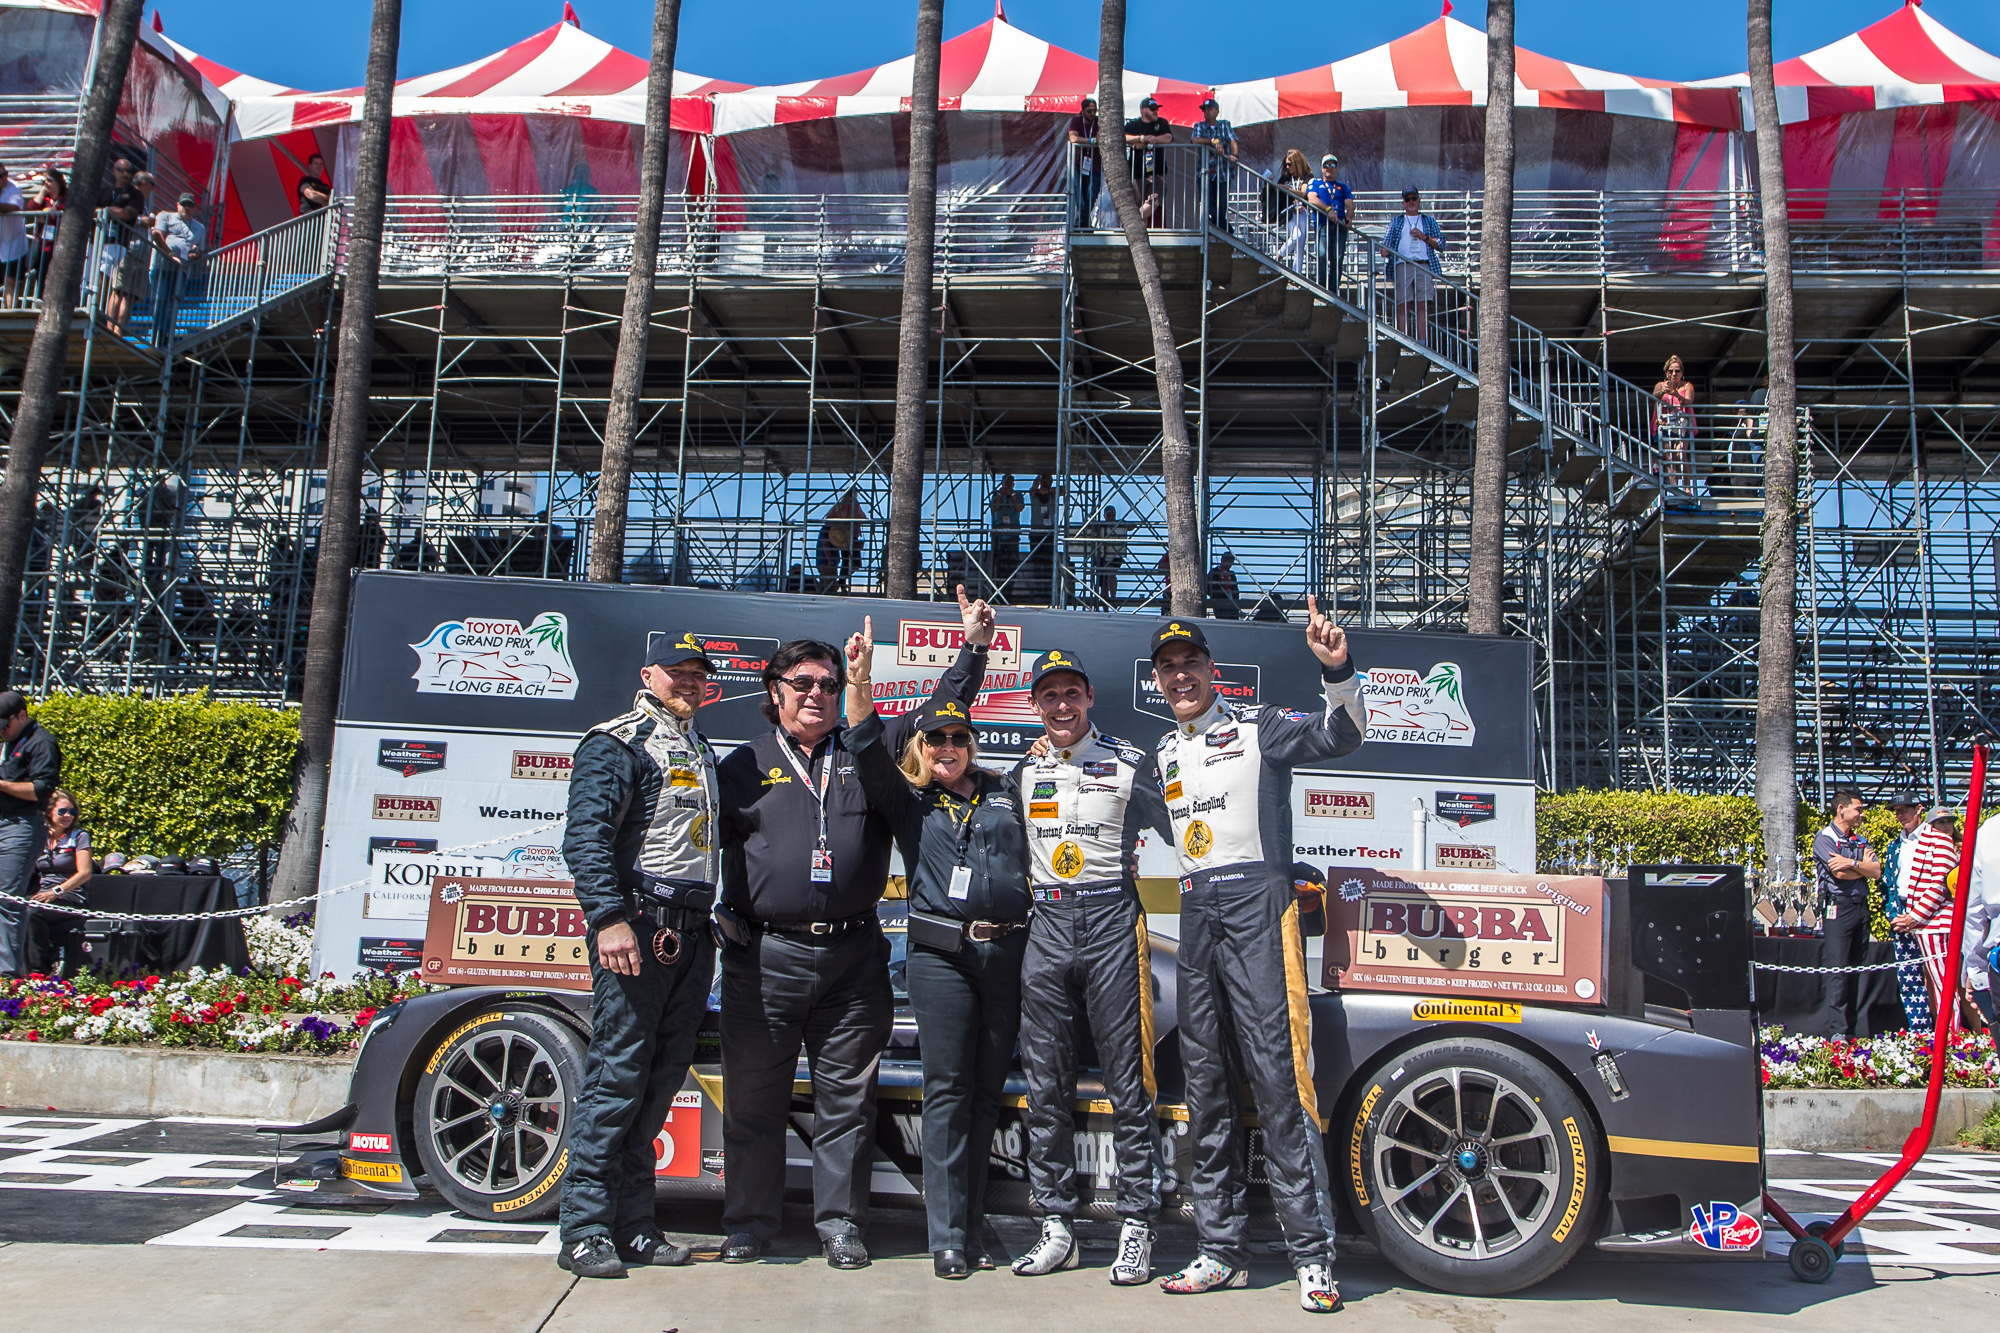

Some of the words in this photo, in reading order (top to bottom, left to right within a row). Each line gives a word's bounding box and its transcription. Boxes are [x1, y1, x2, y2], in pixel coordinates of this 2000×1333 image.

[466, 622, 521, 635] TOYOTA
[455, 635, 503, 648] GRAND
[505, 638, 533, 648] PRIX
[703, 641, 739, 652] IMSA
[906, 628, 1013, 651] BUBA
[1370, 672, 1419, 685] TOYOTA
[449, 680, 492, 693] LONG
[497, 683, 545, 696] BEACH
[1362, 685, 1404, 697] GRAND
[1406, 687, 1432, 698] PRIX
[883, 702, 894, 711] AT
[896, 698, 926, 712] LON
[978, 731, 1021, 745] 2018
[1365, 729, 1397, 740] ONG
[1402, 731, 1446, 743] BEACH
[382, 750, 443, 759] WeatherTech
[1121, 751, 1141, 764] OMP
[517, 755, 575, 769] BUBB
[518, 769, 569, 779] burge
[378, 798, 436, 811] BUBBA
[1193, 796, 1226, 813] Sampling
[1309, 794, 1370, 808] BUBBA
[1438, 801, 1493, 810] WeatherTech
[378, 811, 435, 820] burger
[479, 806, 568, 820] Weather
[1310, 807, 1369, 817] burger
[1036, 825, 1063, 839] Mustang
[1065, 823, 1100, 839] Sampling
[1294, 844, 1401, 859] eatherTech
[1440, 847, 1491, 860] BUBBA
[1441, 859, 1491, 868] burger
[507, 886, 532, 894] U.S.D.A.
[654, 886, 673, 897] OMP
[1372, 880, 1393, 888] MADE
[1394, 880, 1417, 890] FROM
[1417, 882, 1447, 892] U.S.D.A.
[1449, 883, 1479, 893] CHOICE
[1480, 884, 1498, 893] BEEF
[1499, 885, 1527, 895] CHUCK
[373, 891, 431, 900] CALIFORNIA
[1536, 881, 1592, 917] Original
[464, 904, 588, 938] BUBB
[1369, 902, 1553, 943] BUBBA
[362, 949, 423, 957] WeatherTech
[467, 937, 581, 961] burge
[1375, 940, 1543, 968] burger
[428, 961, 441, 970] GF
[448, 967, 457, 975] SIX
[467, 968, 488, 976] GLUTEN
[489, 969, 501, 977] FREE
[502, 969, 526, 977] BURGERS
[530, 970, 543, 978] KEEP
[544, 971, 564, 979] FROZEN
[568, 972, 579, 980] NET
[1352, 973, 1363, 982] SIX
[1364, 974, 1372, 984] (6)
[1376, 975, 1401, 985] GLUTEN
[1401, 976, 1417, 985] FREE
[1418, 977, 1446, 987] BURGERS
[1451, 978, 1467, 988] KEEP
[1468, 979, 1493, 989] FROZEN
[1498, 981, 1511, 990] NET
[1512, 982, 1524, 991] WT.
[1525, 982, 1533, 991] 32
[1534, 983, 1544, 991] OZ.
[1544, 983, 1551, 993] (2
[1551, 984, 1568, 994] LBS.)
[1413, 1001, 1504, 1018] Continental
[429, 1014, 500, 1070] CONTINENTAL
[1404, 1046, 1461, 1067] EXTREME
[1463, 1046, 1530, 1073] CONTACT
[352, 1135, 389, 1150] MOTUL
[1353, 1091, 1382, 1202] CONTINENTAL
[342, 1159, 389, 1177] Continental
[1555, 1122, 1587, 1238] CONTINENTAL
[1690, 1201, 1740, 1249] VP
[1723, 1226, 1760, 1242] Racing
